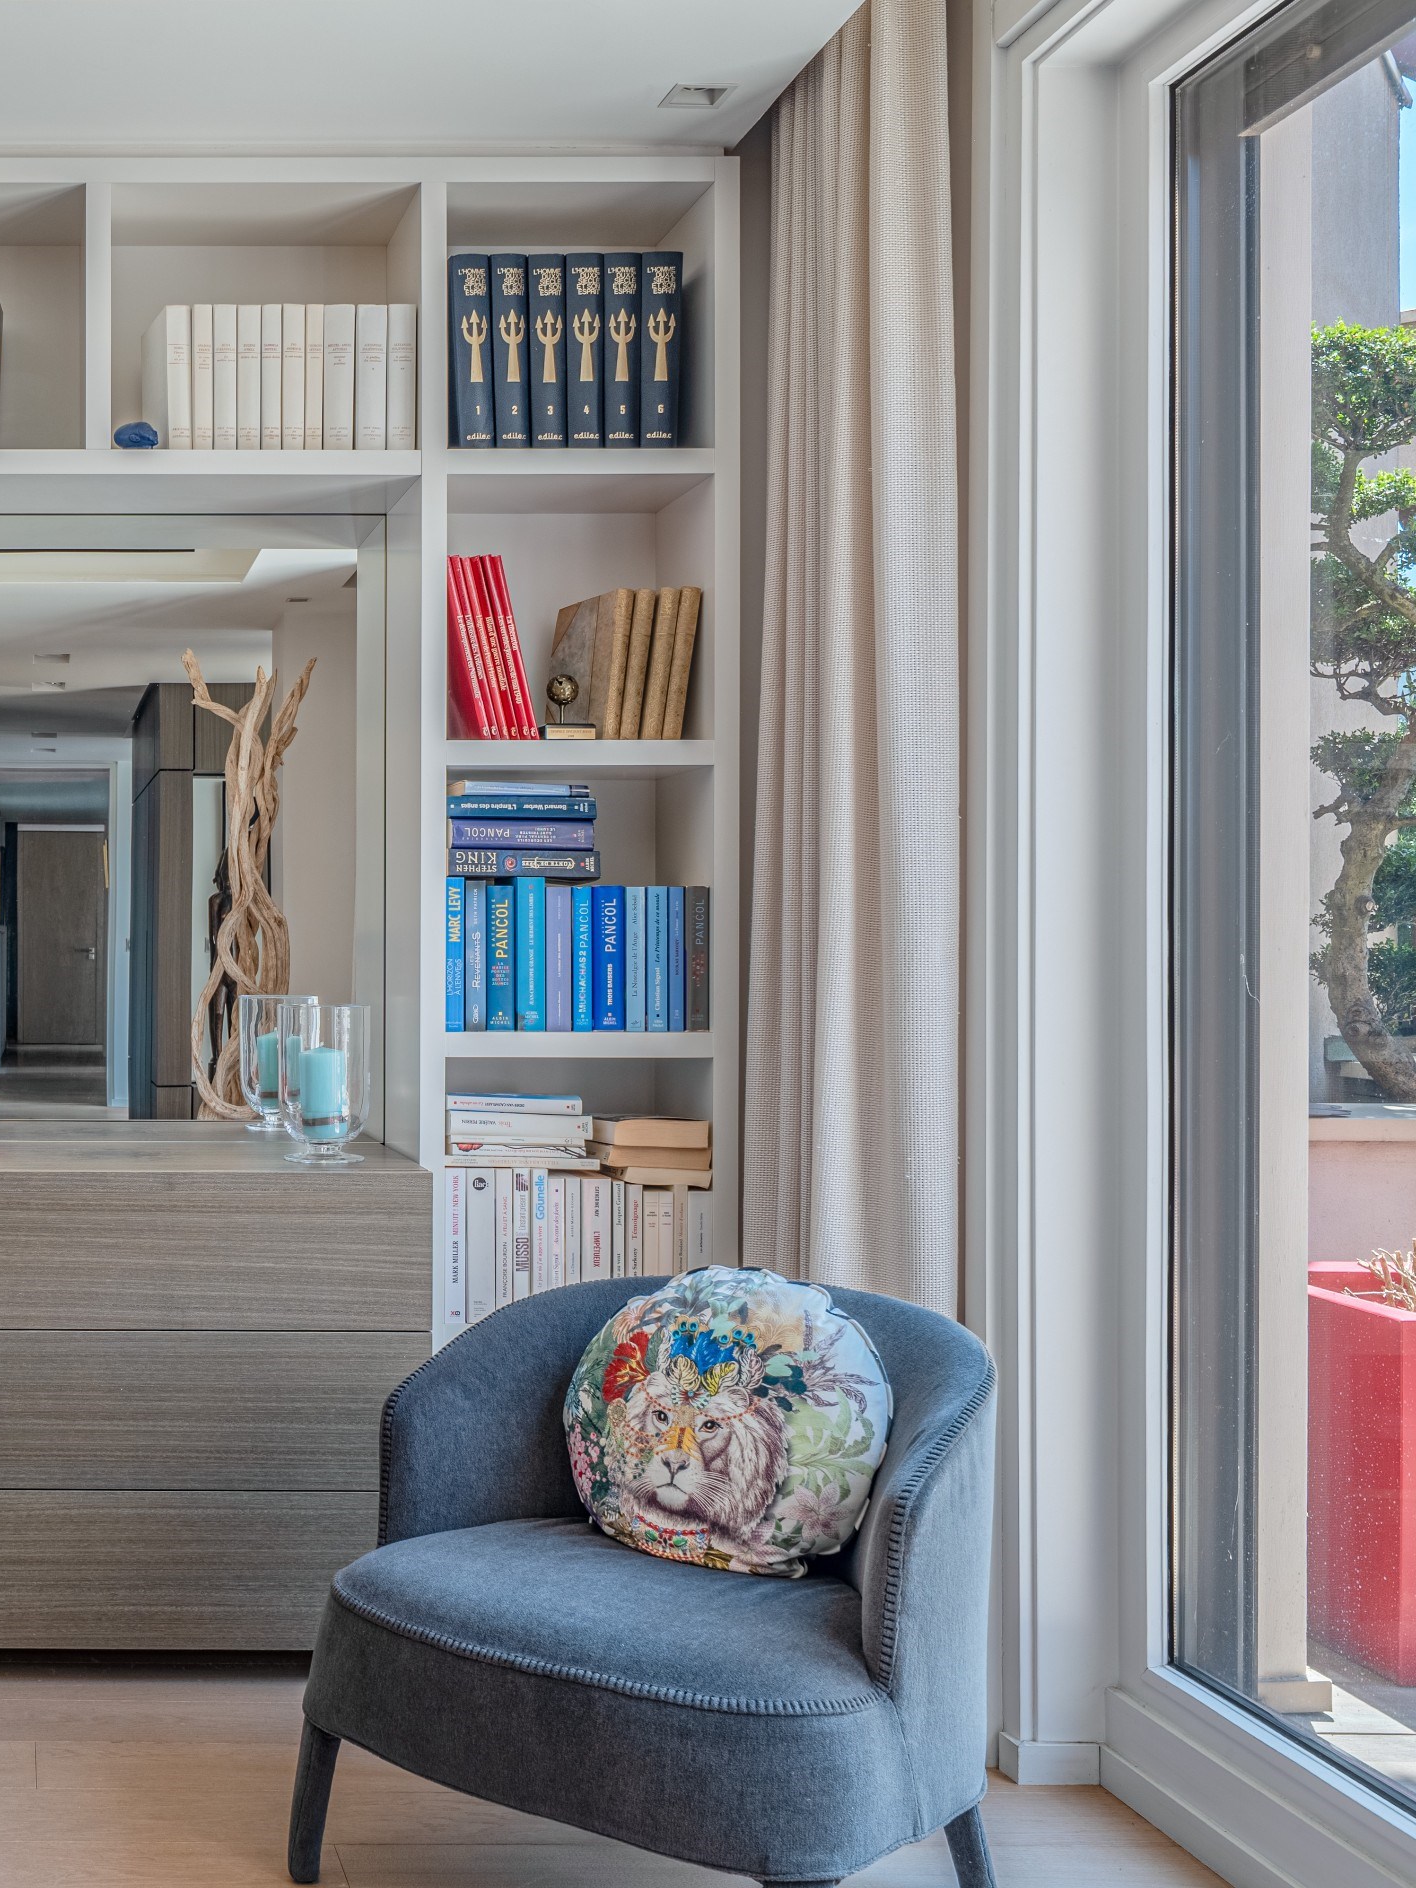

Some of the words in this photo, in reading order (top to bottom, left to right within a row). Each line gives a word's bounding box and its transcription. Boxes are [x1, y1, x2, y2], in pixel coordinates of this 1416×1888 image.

[476, 406, 480, 414] 1
[512, 406, 518, 414] 2
[547, 406, 553, 415] 3
[583, 405, 590, 414] 4
[620, 405, 626, 414] 5
[658, 405, 664, 413] 6
[464, 828, 510, 837] PANCOL
[456, 851, 496, 864] KING
[456, 864, 496, 872] STEPHEN
[449, 886, 460, 911] LEVY
[449, 914, 460, 942] MARC
[496, 899, 508, 958] PANCOL
[579, 899, 589, 947] PANCOL
[605, 898, 616, 952] PANCOL
[696, 899, 704, 944] PANCOL
[472, 931, 481, 988] REVENANTS
[536, 1175, 545, 1220] Gounelle
[516, 1237, 529, 1272] MUSSO
